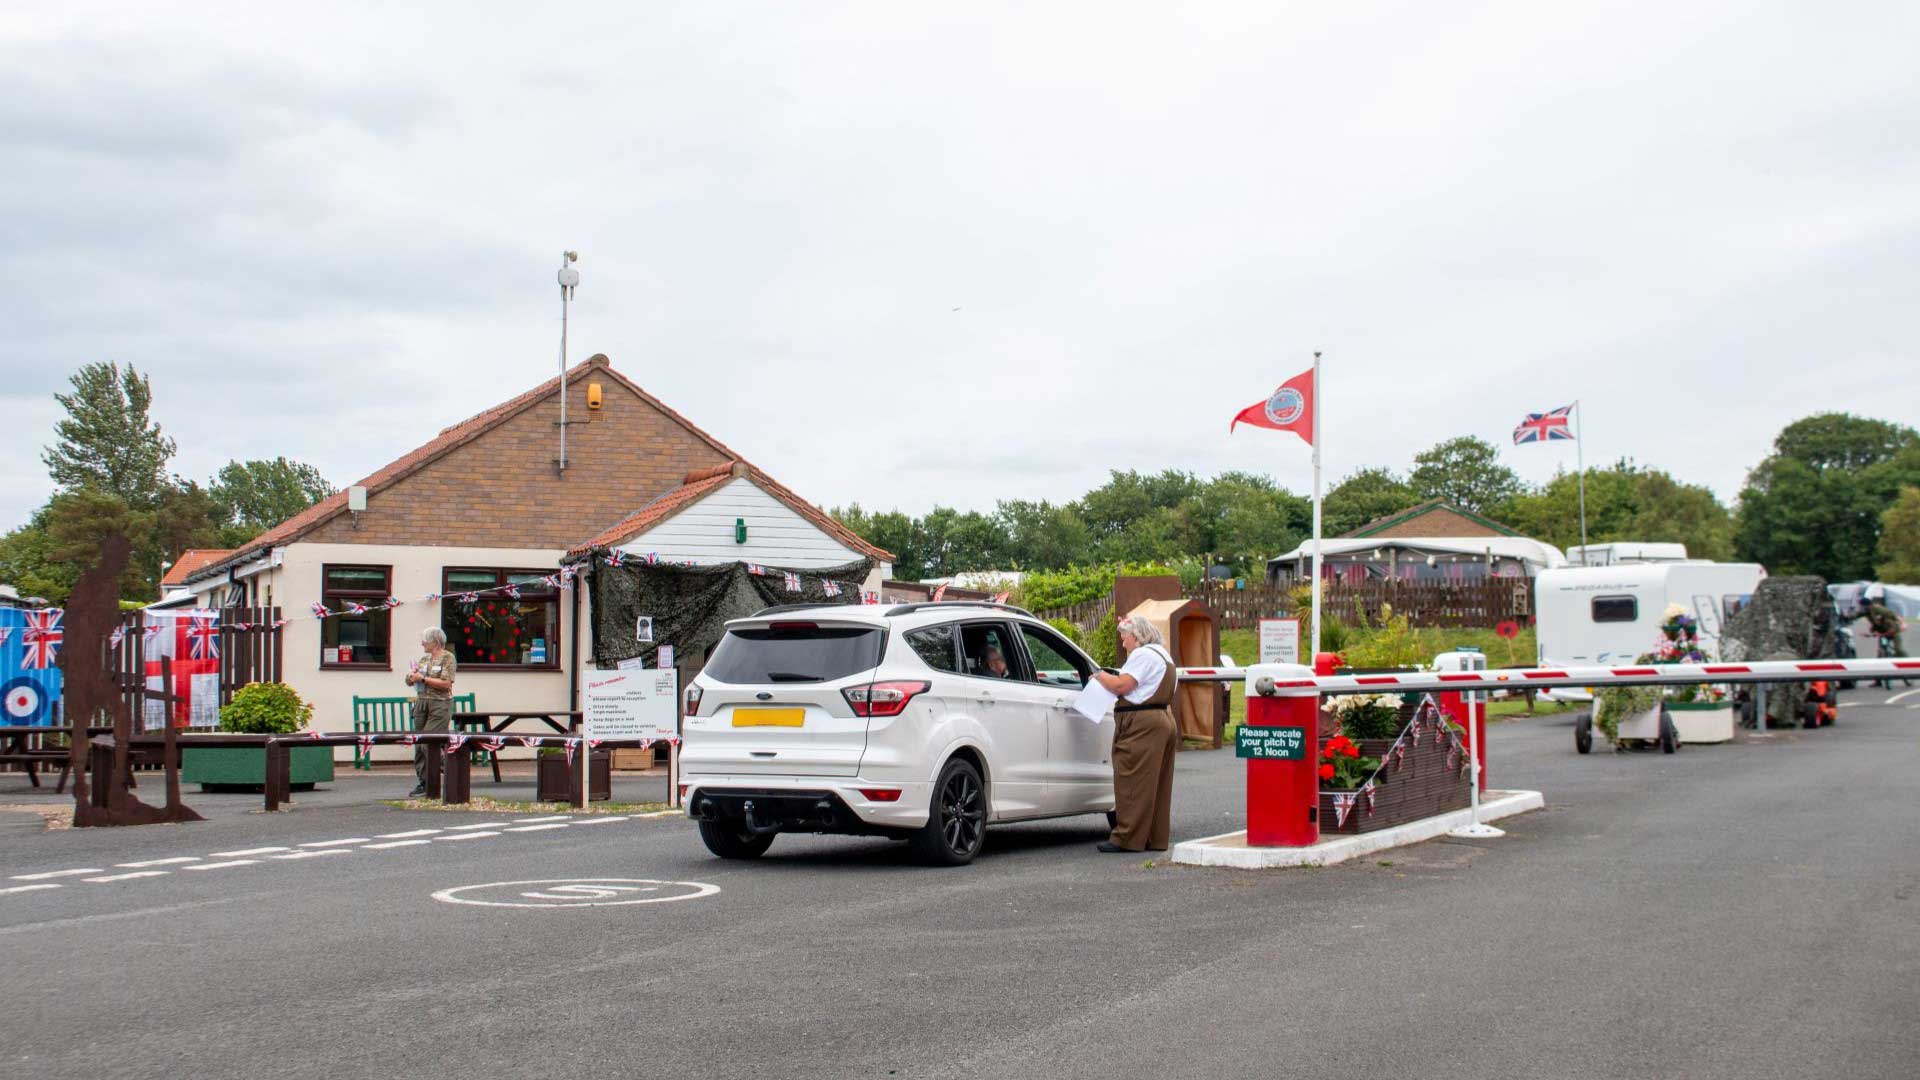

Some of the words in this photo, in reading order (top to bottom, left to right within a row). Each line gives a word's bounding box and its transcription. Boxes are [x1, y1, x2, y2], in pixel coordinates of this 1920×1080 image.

[1239, 727, 1269, 737] Please
[1272, 729, 1302, 738] vacate
[1241, 738, 1261, 747] your
[1264, 737, 1286, 747] pitch
[1288, 738, 1300, 749] by
[1253, 747, 1263, 756] 12
[1265, 747, 1289, 757] Noon
